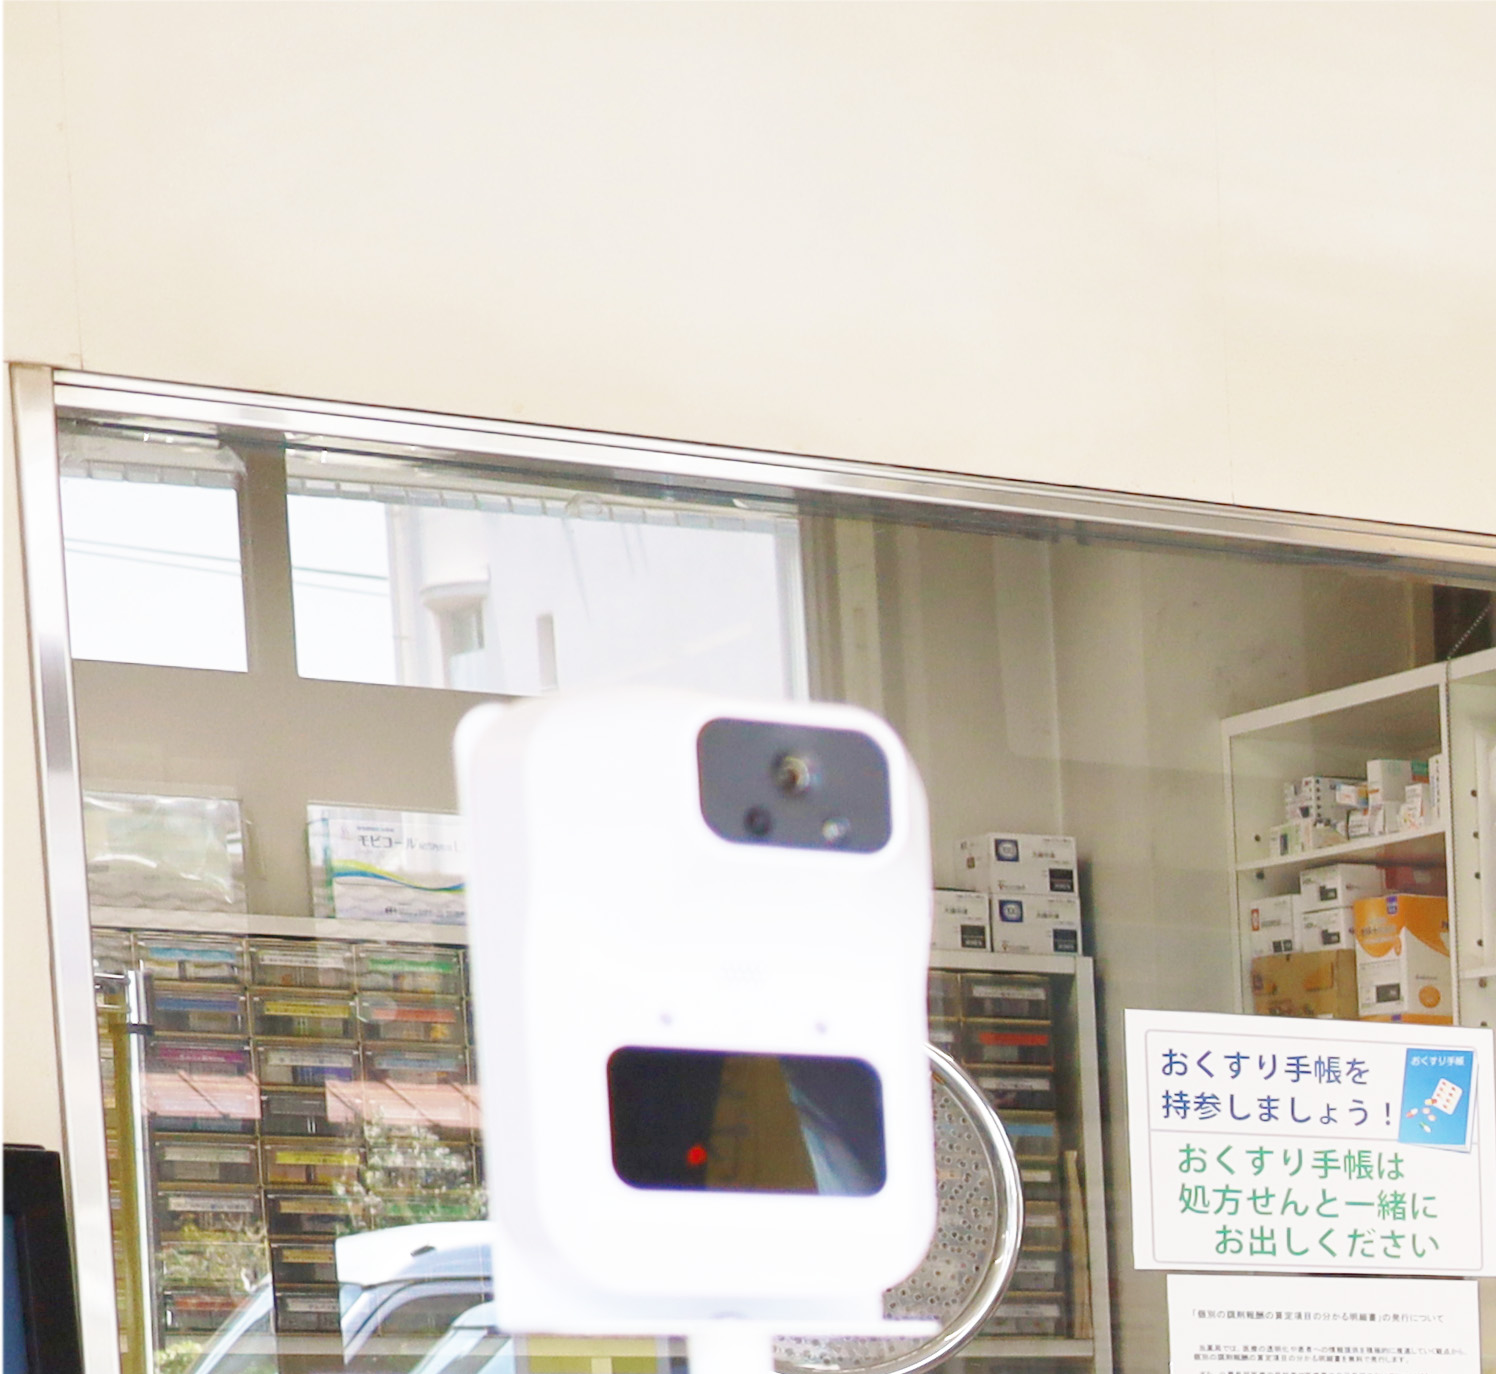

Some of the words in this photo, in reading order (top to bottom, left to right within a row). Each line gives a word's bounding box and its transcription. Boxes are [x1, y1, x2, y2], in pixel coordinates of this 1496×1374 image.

[1161, 1048, 1370, 1085] おくすり手帳を
[1410, 1054, 1465, 1067] おくすり手帳
[1161, 1089, 1392, 1127] 持参しましょう！
[1178, 1143, 1406, 1181] おくすり手帳は
[1178, 1183, 1439, 1222] 処方せんと一緒に
[1214, 1224, 1440, 1259] お出しください
